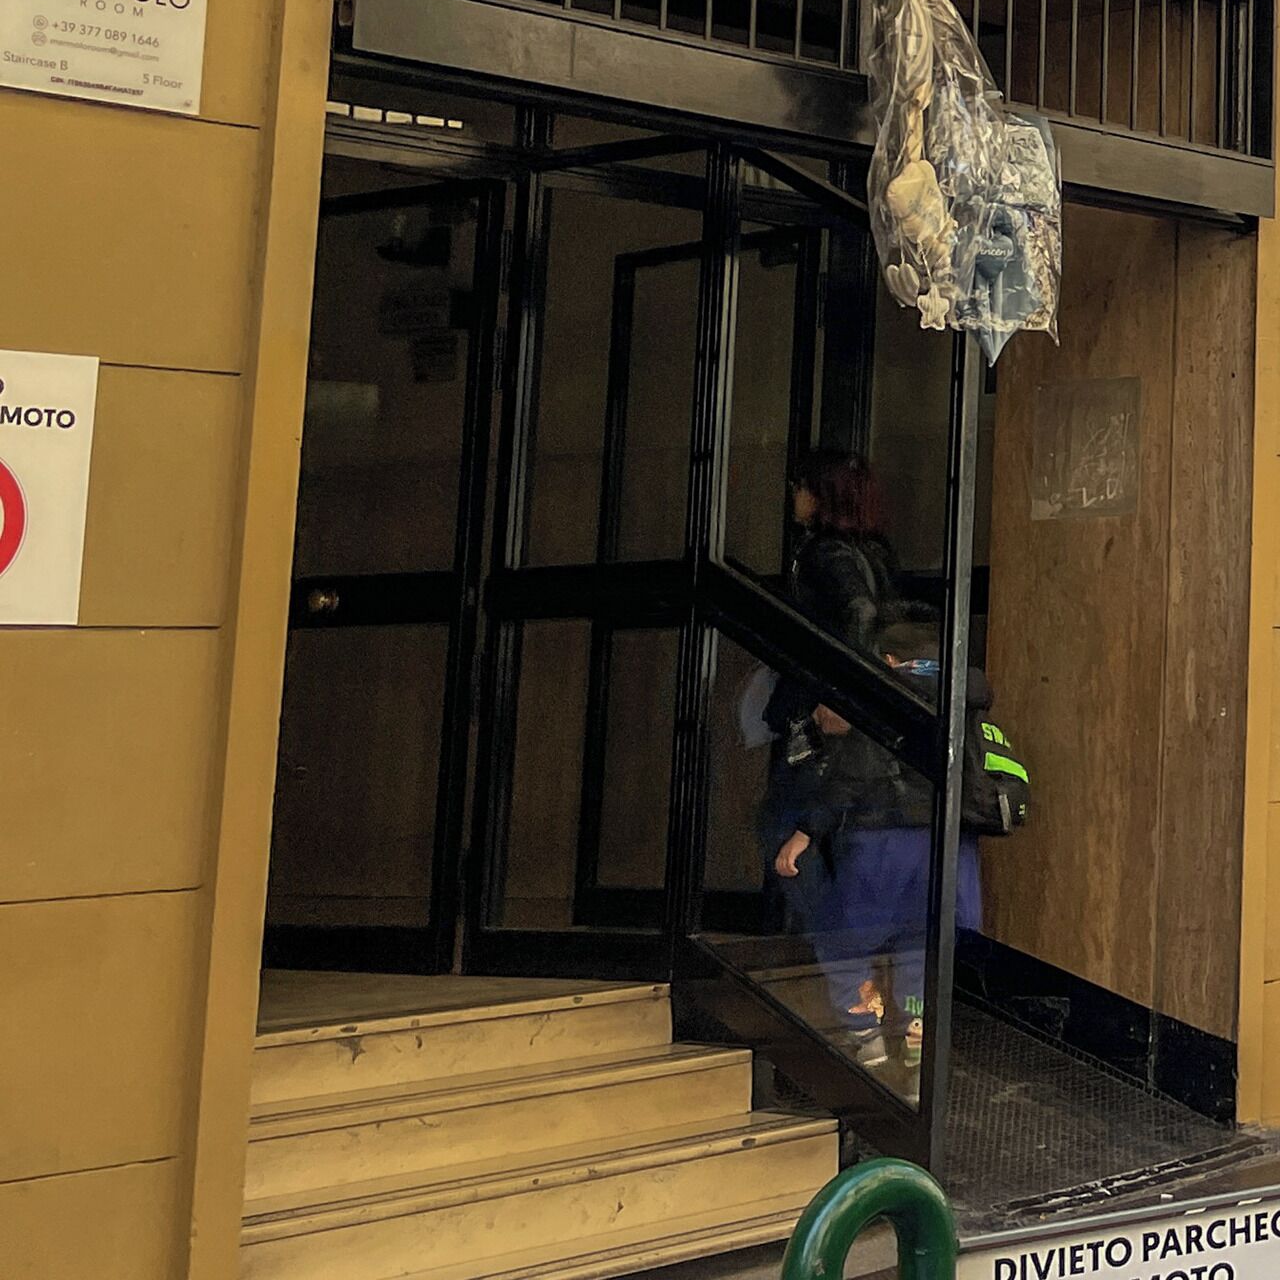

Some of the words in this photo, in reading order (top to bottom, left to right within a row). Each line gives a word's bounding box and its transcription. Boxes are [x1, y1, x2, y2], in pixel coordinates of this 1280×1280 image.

[52, 20, 76, 33] +39
[79, 24, 102, 37] 377
[104, 28, 127, 42] 089
[131, 33, 160, 48] 1646
[3, 51, 57, 70] Staircase
[59, 60, 69, 71] B
[152, 76, 183, 89] Floor
[0, 405, 75, 429] MOTO
[994, 1237, 1132, 1280] DIVIETO
